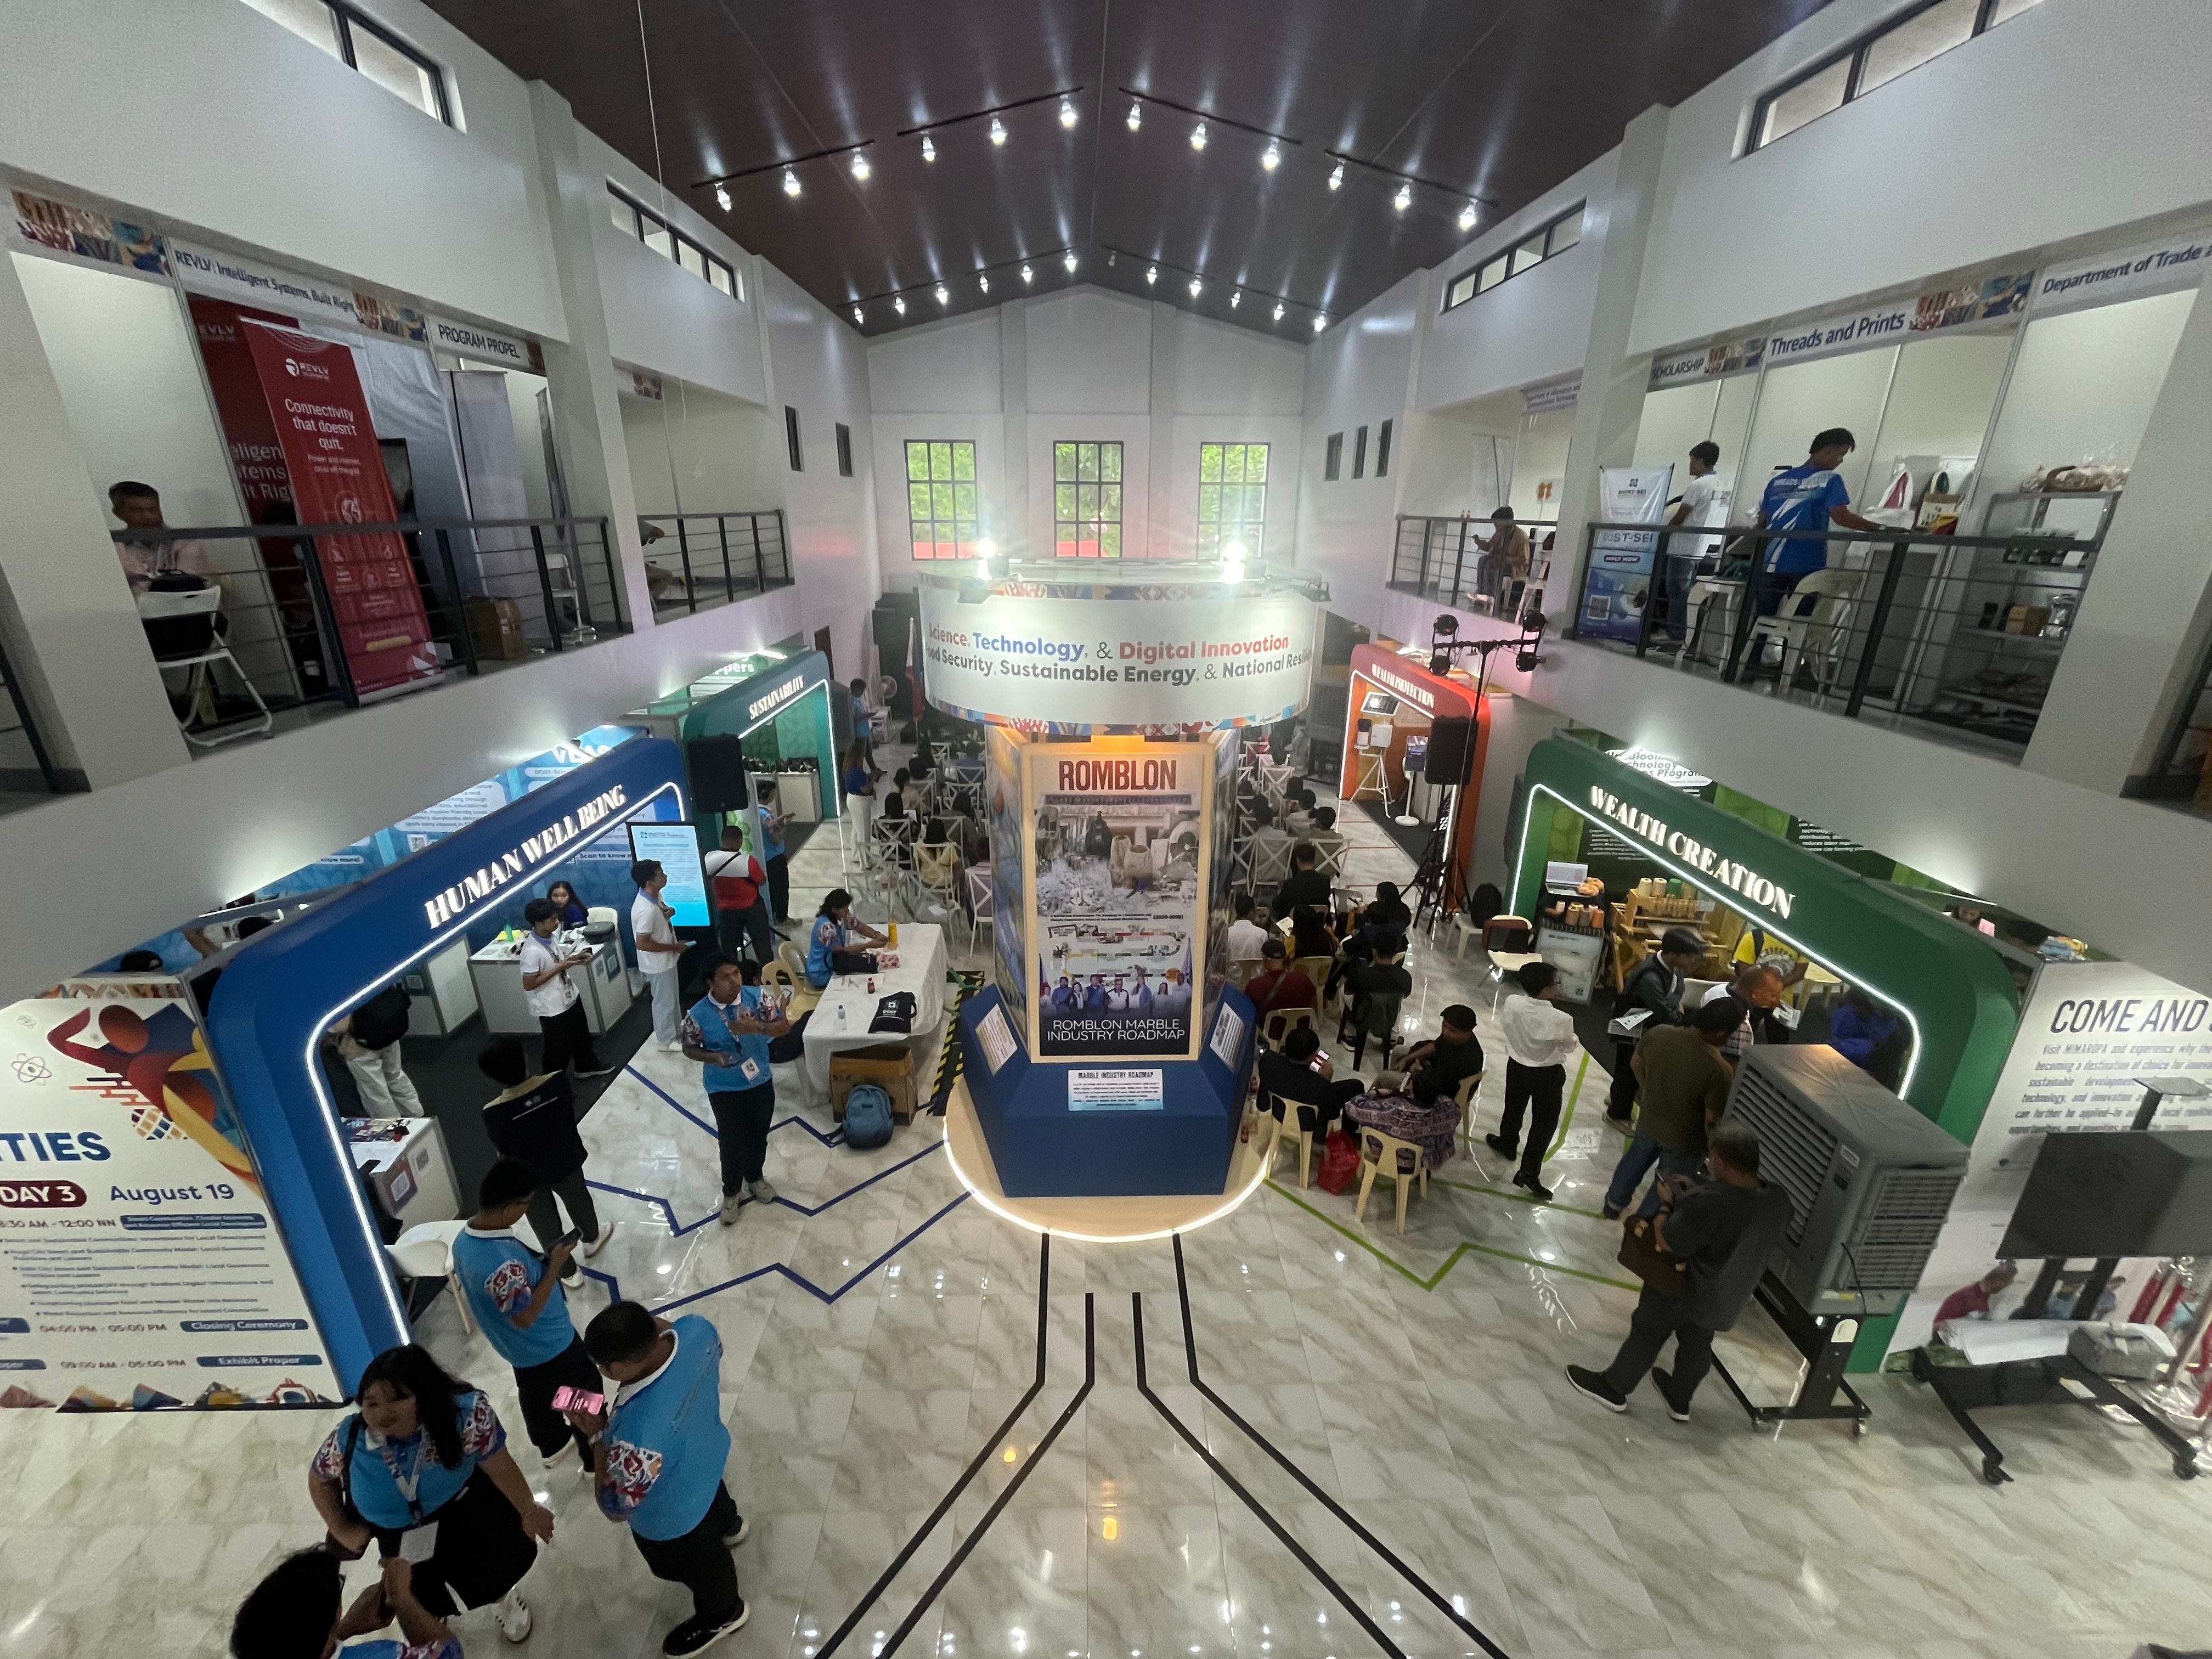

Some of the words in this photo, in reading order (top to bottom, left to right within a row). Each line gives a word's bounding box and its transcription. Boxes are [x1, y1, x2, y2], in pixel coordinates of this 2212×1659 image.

[2042, 262, 2131, 294] Department
[2135, 255, 2154, 272] of
[2156, 245, 2203, 269] Trade
[217, 263, 269, 289] Intelligent
[311, 290, 331, 305] Built
[334, 296, 356, 312] Right
[438, 324, 486, 351] PROGRAM
[488, 338, 521, 359] PROPEL
[1772, 329, 1822, 356] Threads
[1825, 321, 1856, 344] and
[1857, 312, 1906, 338] Prints
[300, 362, 329, 375] REVLV
[1652, 358, 1704, 380] SCHOLARSHIP
[284, 399, 354, 422] Connectivity
[292, 416, 317, 431] that
[318, 421, 357, 436] doesn't
[319, 438, 343, 450] quit.
[928, 623, 970, 647] Science,
[973, 632, 1088, 662] Technology,
[1096, 642, 1113, 659] &
[1120, 641, 1195, 664] Digital
[1201, 635, 1288, 658] Innovation
[942, 648, 997, 677] Security,
[1001, 659, 1119, 682] Sustainable
[1124, 666, 1199, 686] Energy,
[1204, 663, 1217, 680] &
[1222, 654, 1284, 678] National
[749, 675, 803, 720] SUSTAINABILITY
[1372, 663, 1395, 687] WEALTH
[1395, 676, 1435, 709] PROTECTION
[1059, 760, 1176, 791] ROMBLON
[425, 849, 522, 929] HUMAN
[521, 816, 579, 864] WELL
[577, 784, 626, 830] BEING
[1592, 785, 1667, 847] WEALTH
[1669, 832, 1796, 920] CREATION
[1053, 1019, 1122, 1030] ROMBLON
[1126, 1019, 1180, 1030] MARBLE
[2050, 1000, 2141, 1033] COME
[2137, 1000, 2209, 1032] AND
[1047, 1030, 1114, 1041] INDUSTRY
[1118, 1029, 1185, 1040] ROADMAP
[0, 1132, 111, 1161] TIES
[0, 1186, 50, 1202] DAY
[55, 1186, 76, 1202] 3
[111, 1185, 201, 1205] August
[205, 1184, 234, 1200] 19
[59, 1220, 94, 1228] 12:00
[108, 1324, 145, 1332] 05:00
[191, 1322, 236, 1331] Closing
[237, 1320, 296, 1330] Ceremony
[218, 1357, 259, 1365] Exhibit
[262, 1356, 301, 1365] Proper
